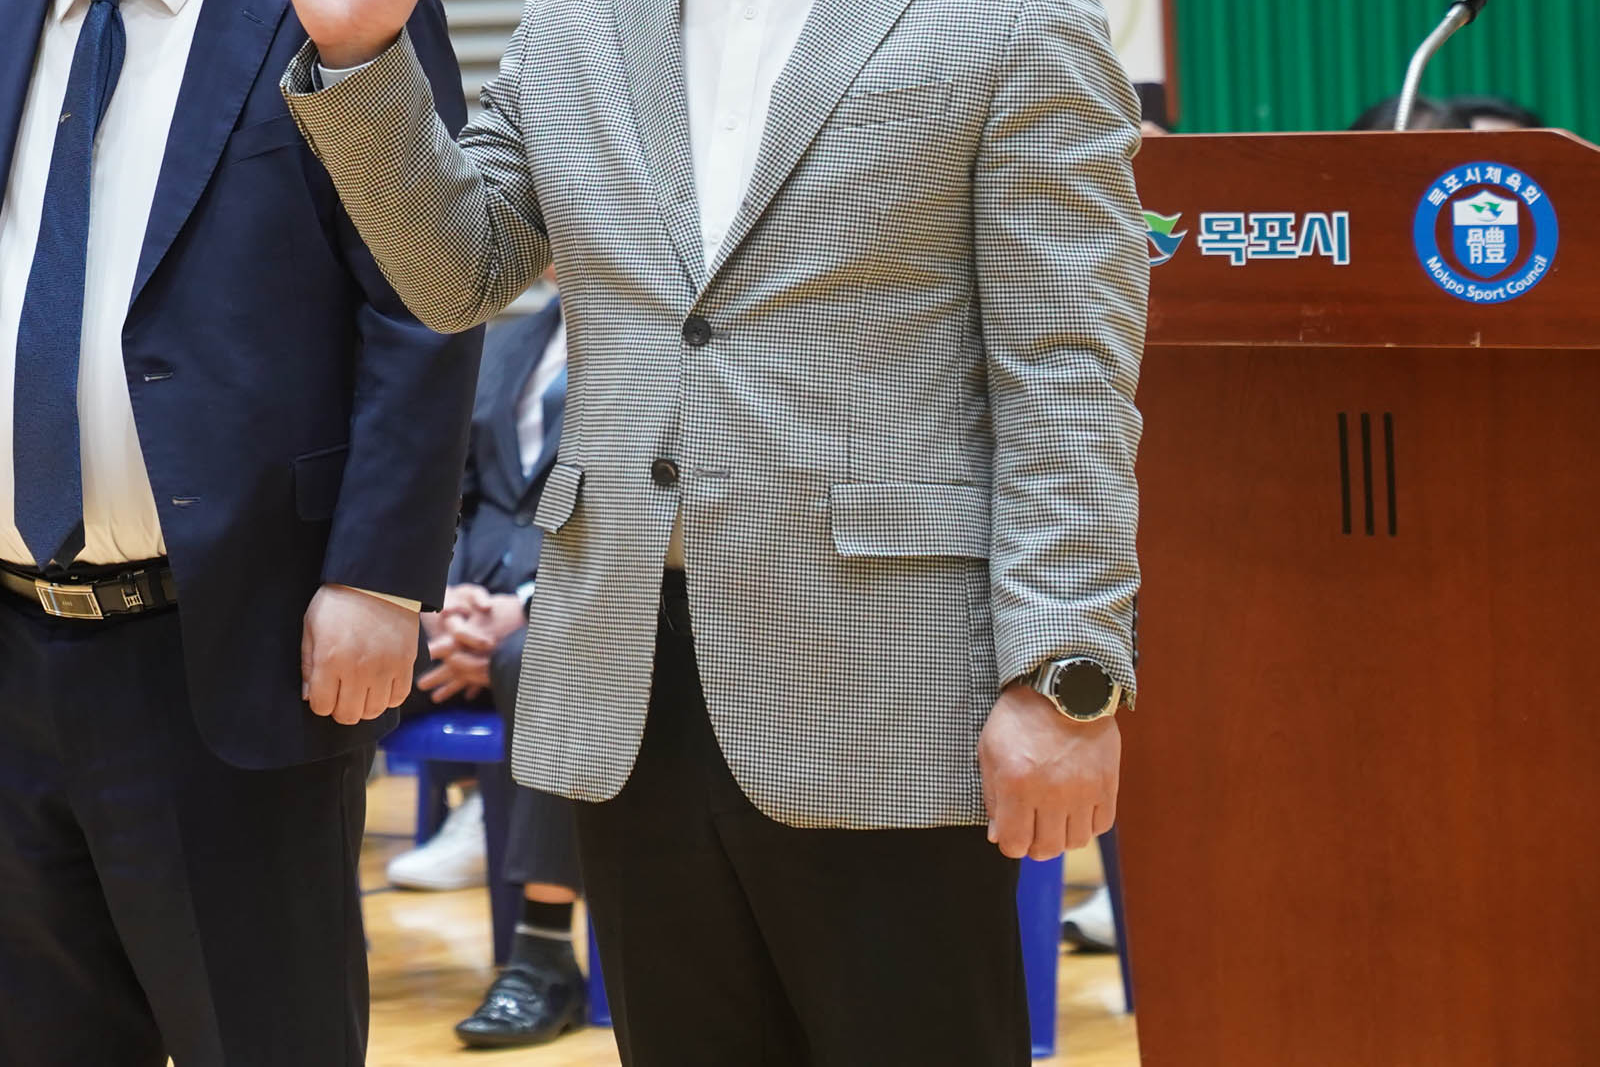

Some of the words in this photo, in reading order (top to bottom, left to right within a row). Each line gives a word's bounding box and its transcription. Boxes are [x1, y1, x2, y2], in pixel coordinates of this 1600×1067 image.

[1427, 166, 1541, 207] 목포시체육회
[1198, 211, 1351, 266] 목포시
[1466, 226, 1507, 265] 體
[1426, 255, 1465, 295] Mokpo
[1466, 284, 1507, 301] Sport
[1506, 254, 1549, 295] Council
